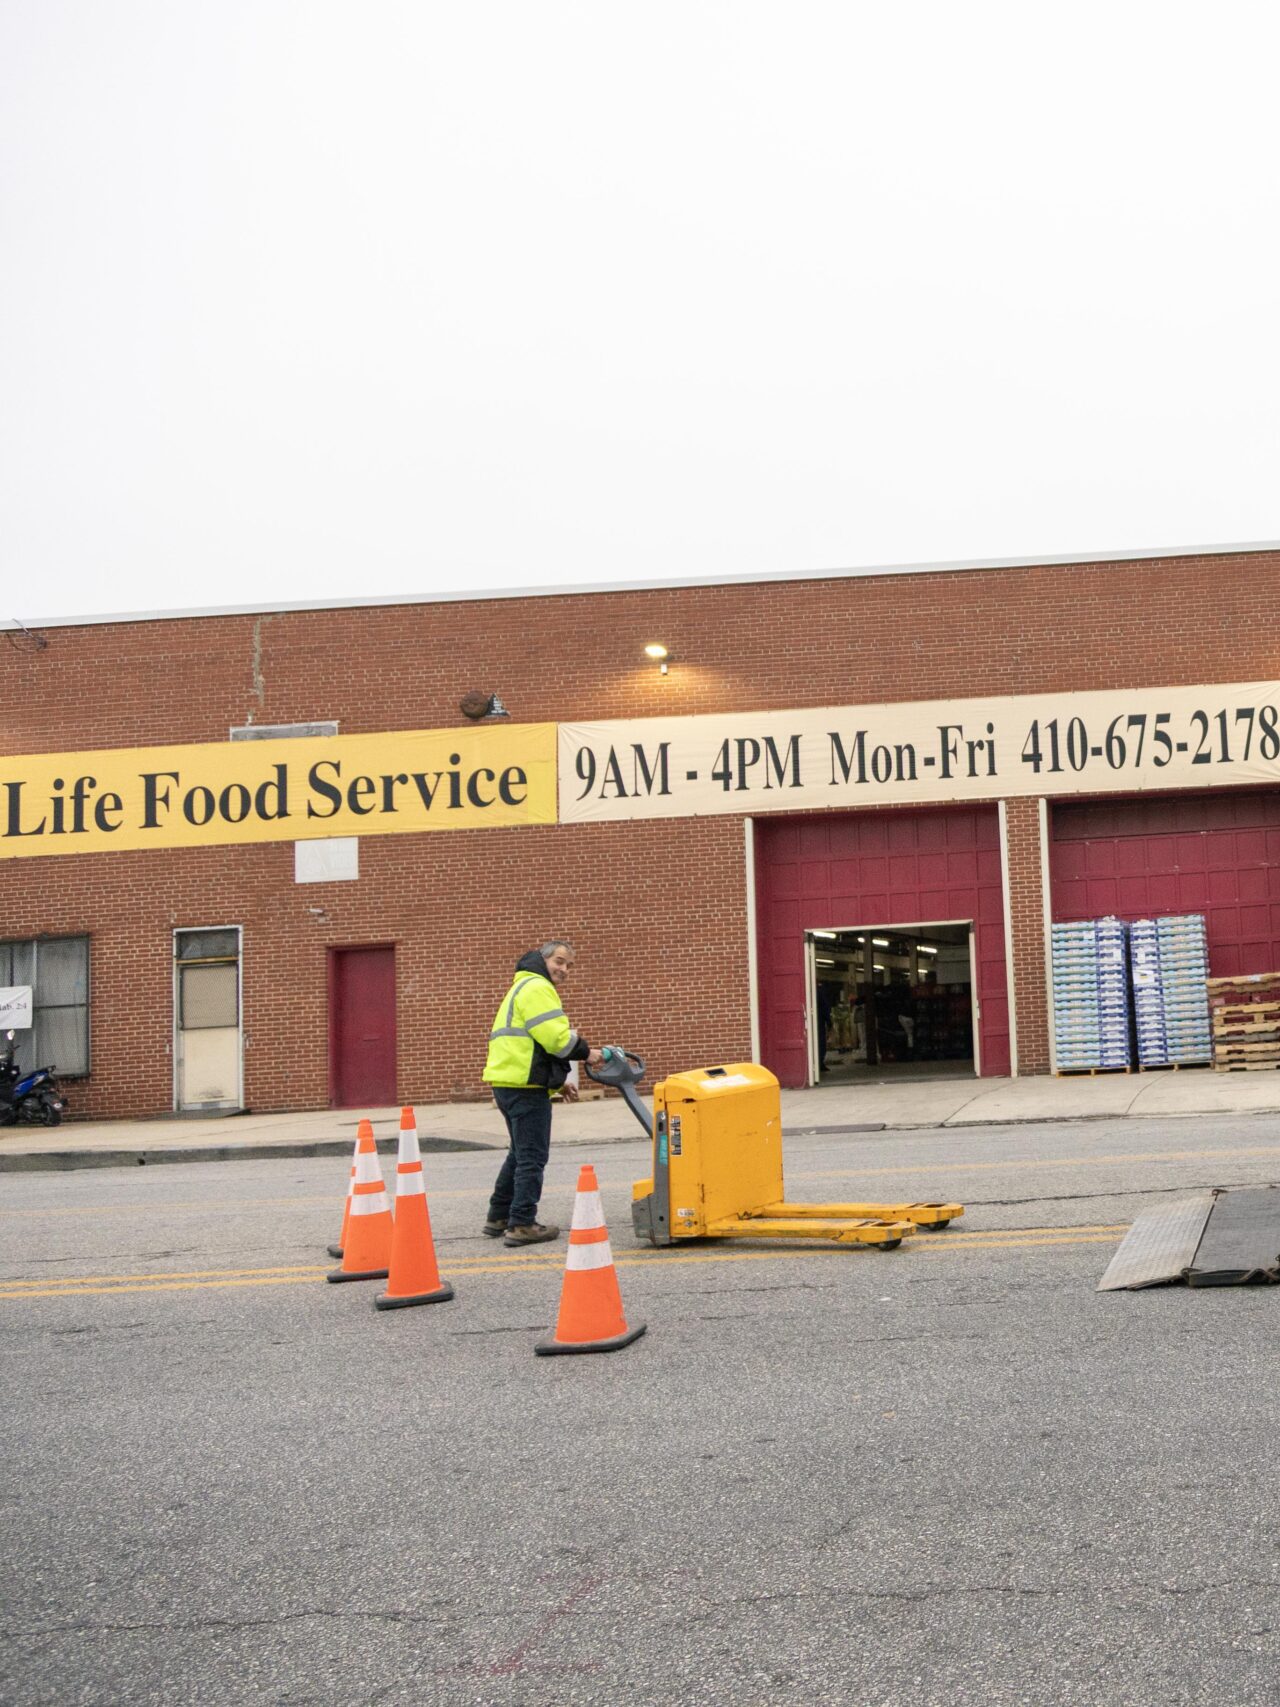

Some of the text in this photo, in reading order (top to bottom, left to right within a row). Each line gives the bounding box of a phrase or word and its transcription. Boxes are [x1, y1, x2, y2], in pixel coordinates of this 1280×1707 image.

[1, 753, 528, 837] Life Food Service
[576, 742, 672, 800] 9AM
[711, 735, 804, 793] 4PM
[828, 722, 998, 786] Mon-Fri
[1021, 704, 1280, 774] 410-675-2178
